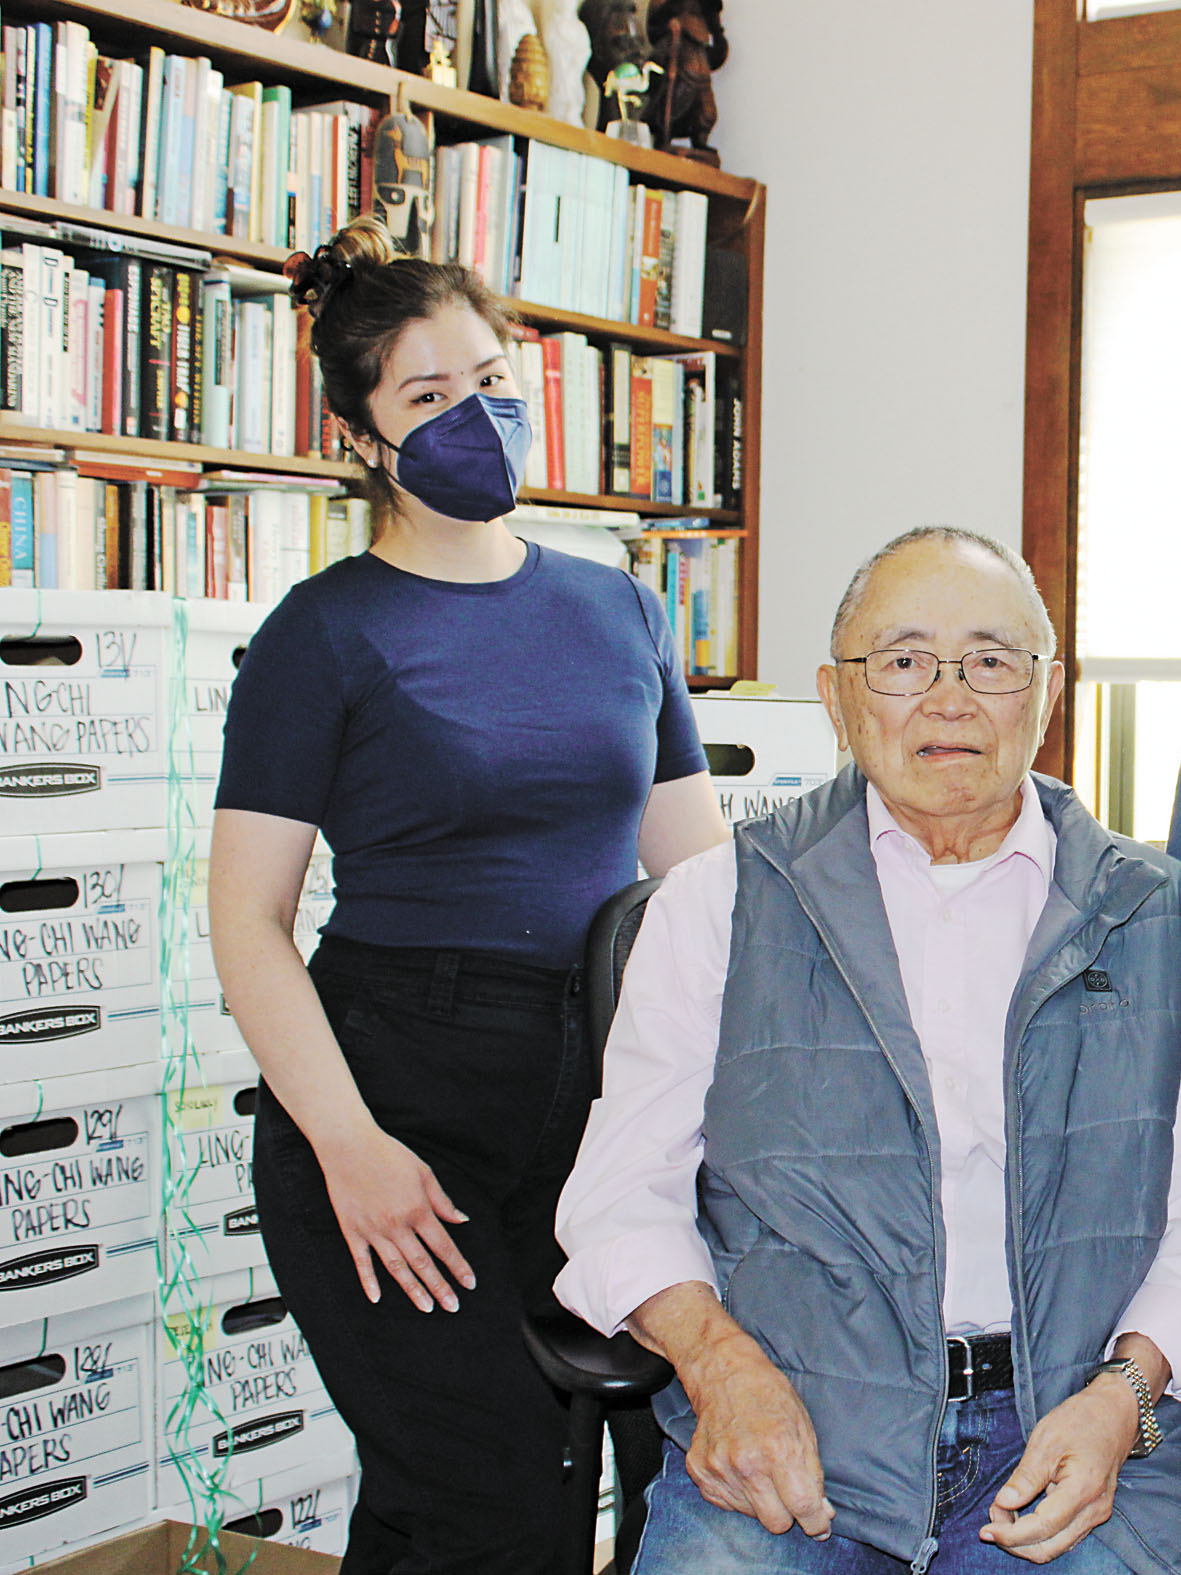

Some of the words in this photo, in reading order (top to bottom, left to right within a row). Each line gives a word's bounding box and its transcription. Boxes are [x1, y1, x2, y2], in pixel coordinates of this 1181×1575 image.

[128, 265, 140, 333] ESPIONAGE
[150, 277, 162, 349] SPYCRAFT
[732, 398, 743, 439] JOHN
[731, 440, 742, 491] ADAMS
[14, 497, 26, 560] CHINA
[76, 716, 151, 758] PAPERS
[64, 772, 97, 786] BOX
[22, 957, 103, 997] PAPERS
[65, 1012, 97, 1027] BOX
[0, 1159, 84, 1206] NG-CHI
[89, 1155, 145, 1190] WANG
[11, 1198, 91, 1242] PAPERS
[63, 1250, 96, 1267] BOX
[202, 1341, 275, 1388] NG-CHI
[49, 1381, 112, 1429] WANG
[230, 1366, 297, 1412] PAPERS
[275, 1416, 303, 1434] BOX
[50, 1483, 83, 1503] BOX
